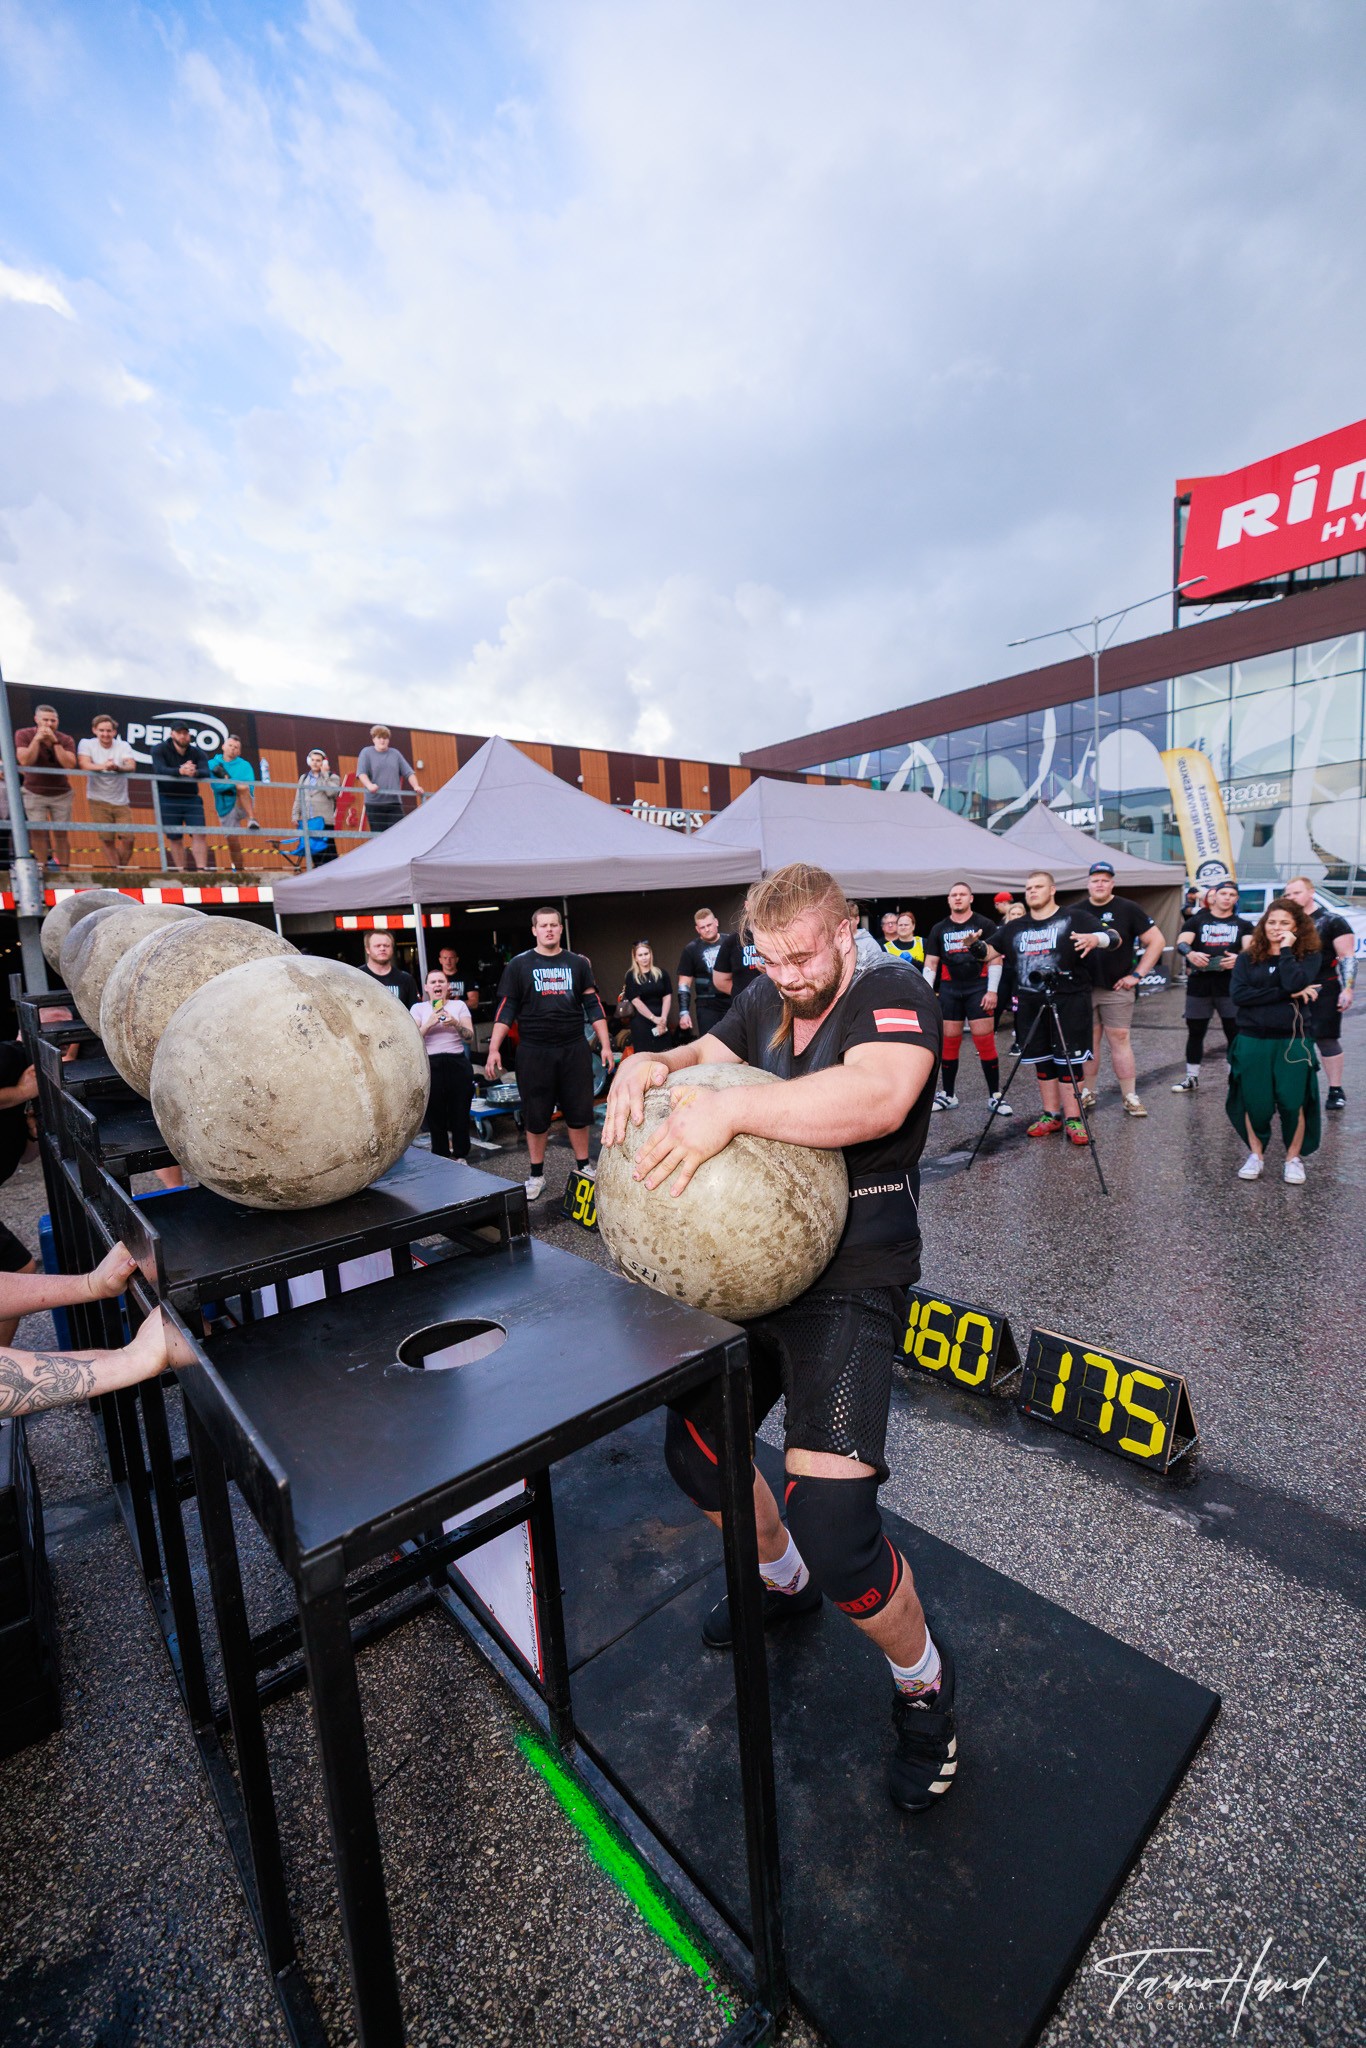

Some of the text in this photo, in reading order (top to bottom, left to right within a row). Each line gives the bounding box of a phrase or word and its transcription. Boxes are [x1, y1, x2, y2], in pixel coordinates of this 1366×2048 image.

[628, 1261, 658, 1283] 175
[903, 1299, 994, 1387] 160
[1051, 1351, 1167, 1458] 175
